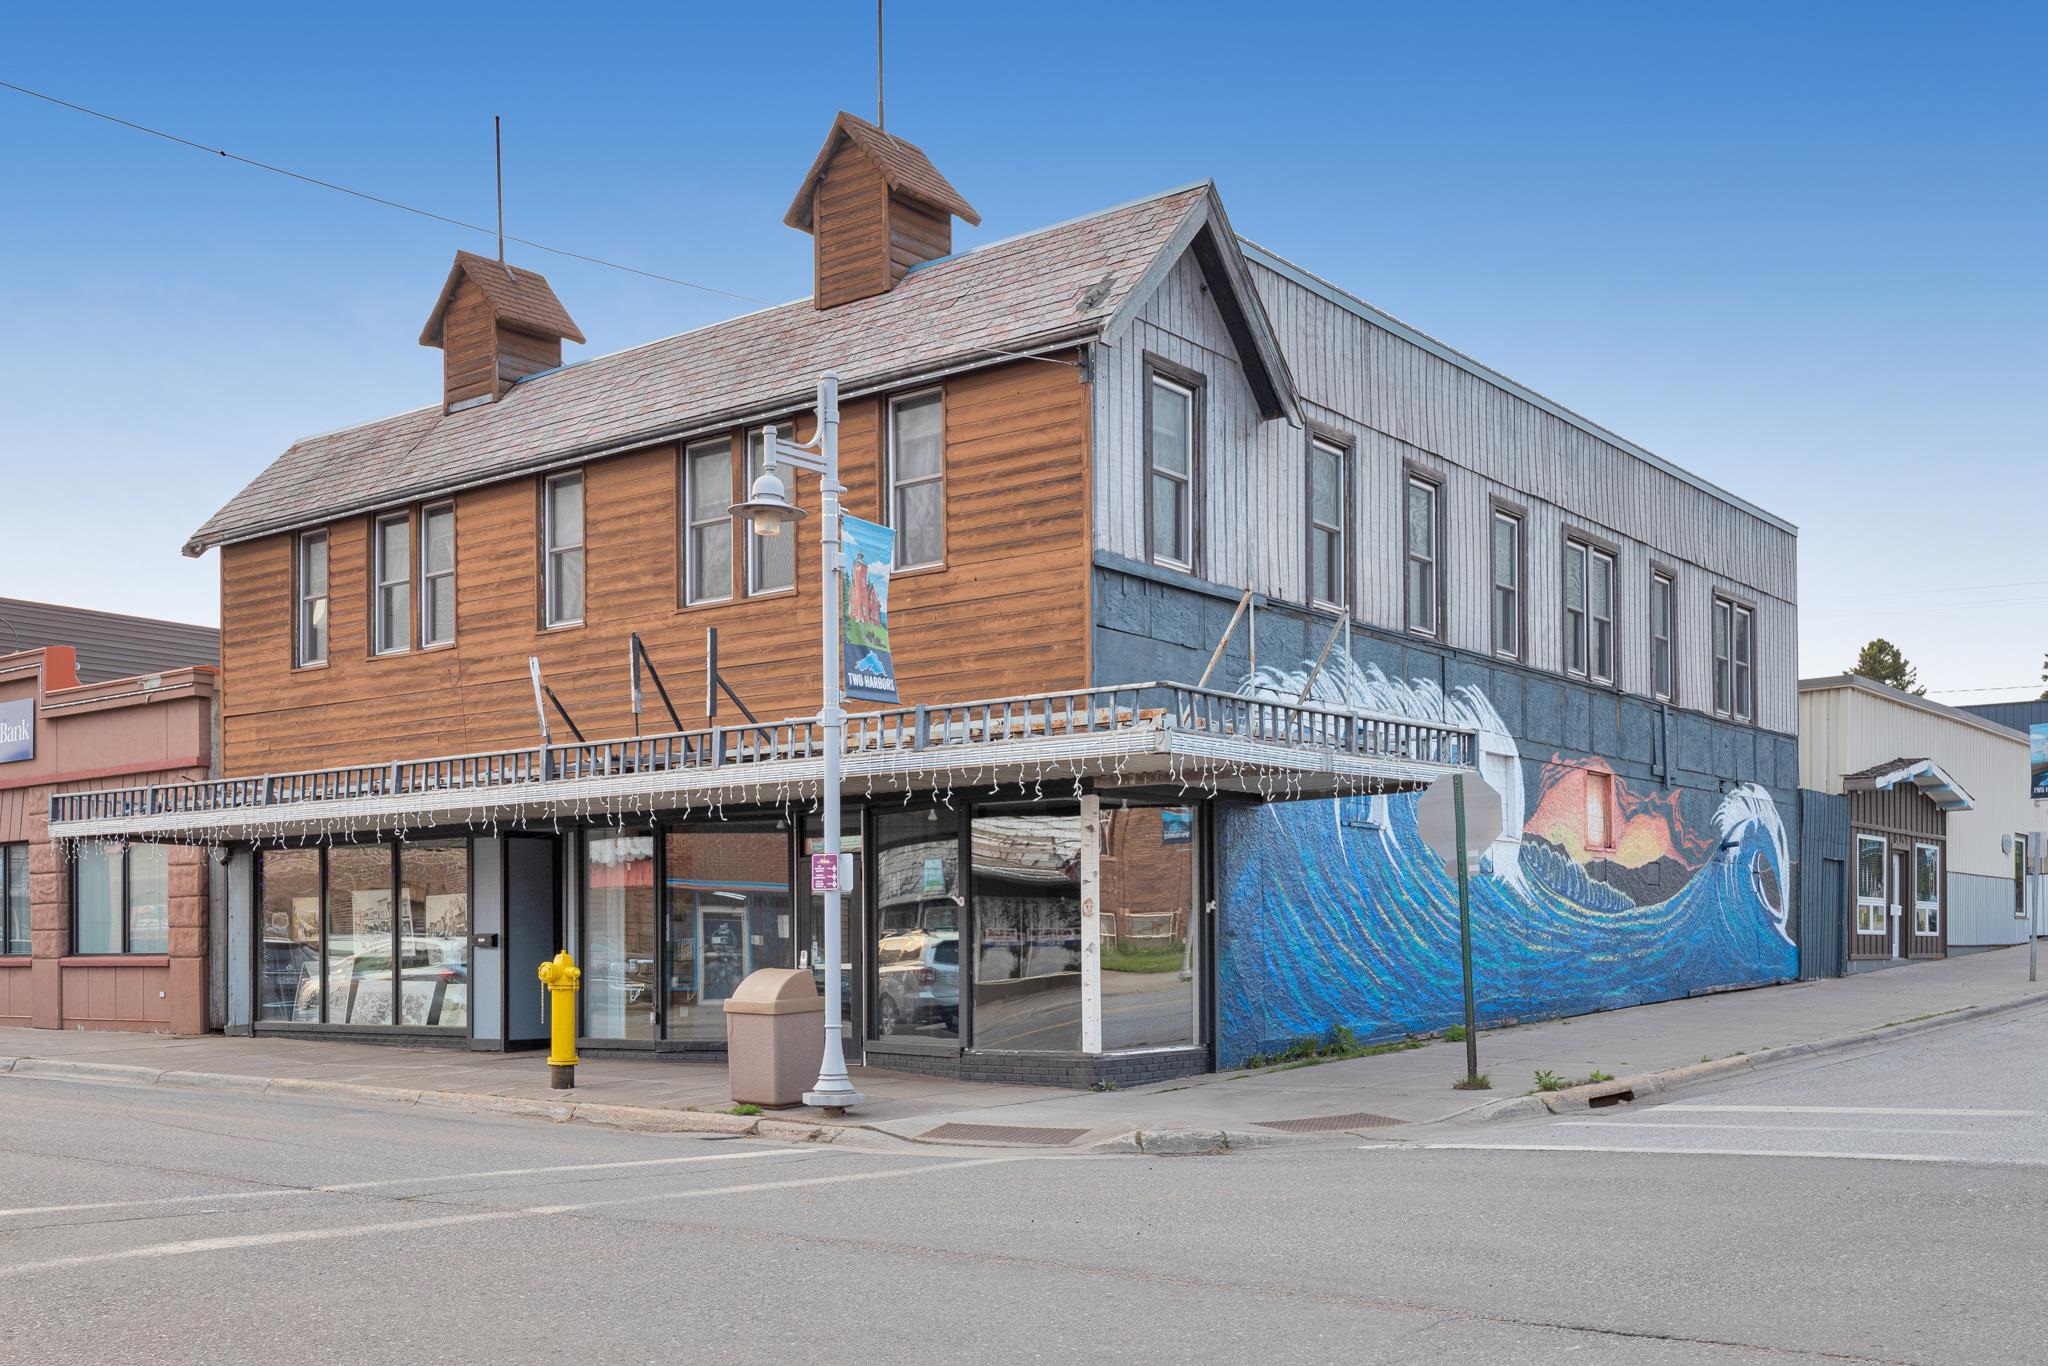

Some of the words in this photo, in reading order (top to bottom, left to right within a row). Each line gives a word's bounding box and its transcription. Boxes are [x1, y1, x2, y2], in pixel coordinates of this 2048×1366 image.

[848, 672, 864, 687] TWO
[864, 675, 895, 691] HARBORS
[0, 719, 29, 743] Bank
